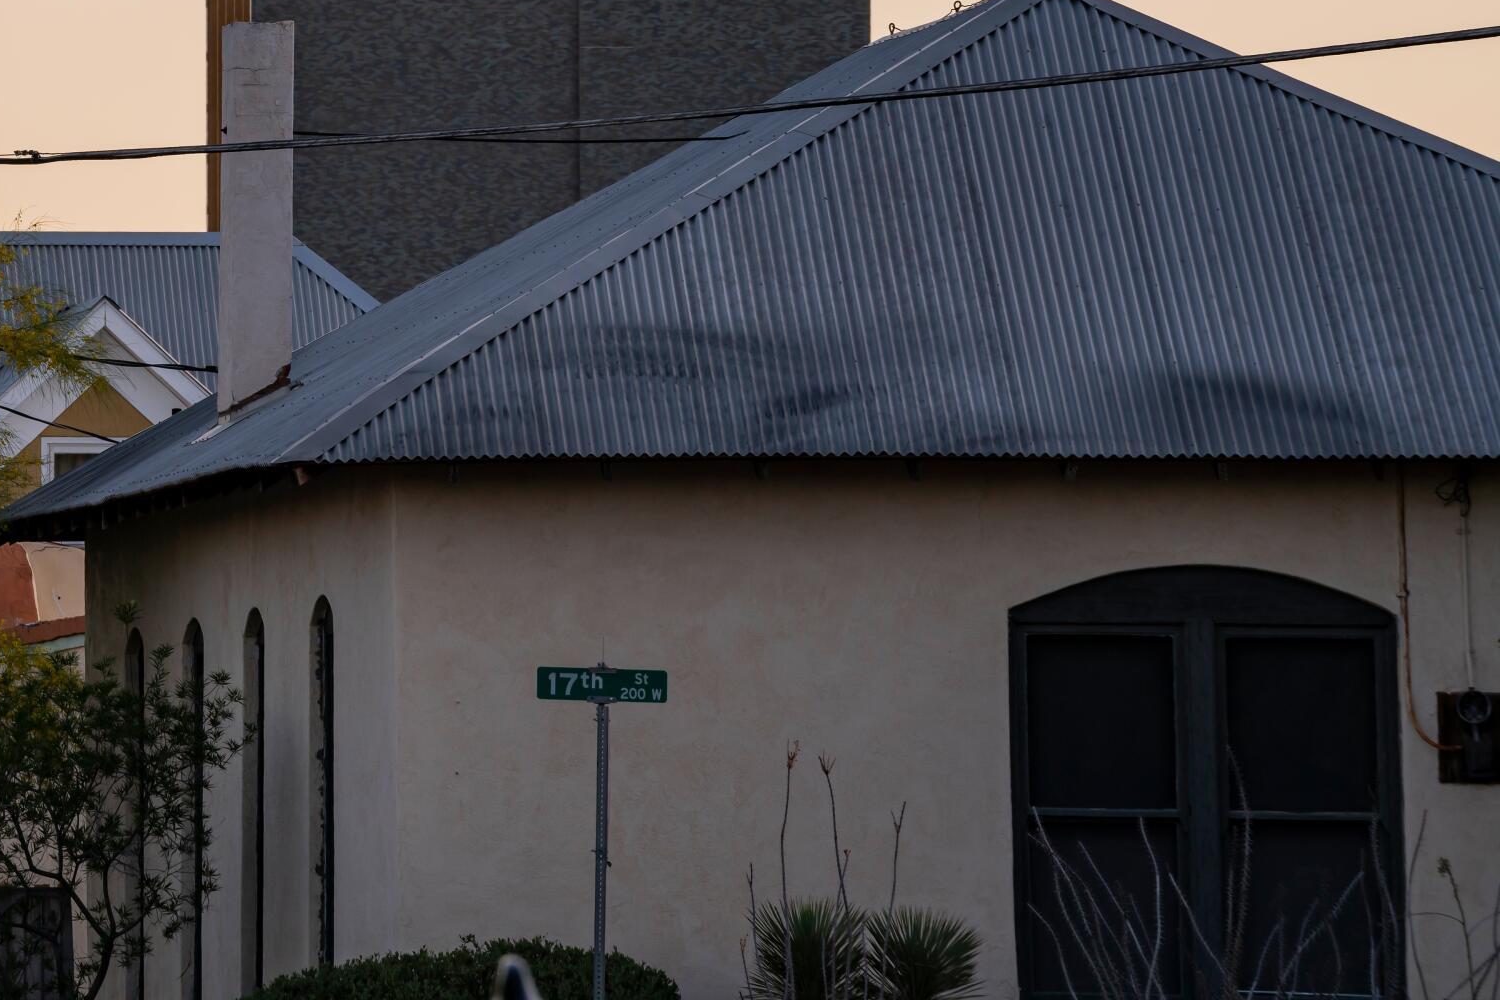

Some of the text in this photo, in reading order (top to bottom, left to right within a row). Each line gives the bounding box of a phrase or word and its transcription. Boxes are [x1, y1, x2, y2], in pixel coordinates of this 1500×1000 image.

[548, 671, 648, 695] 17th St
[620, 688, 662, 700] 200 W
